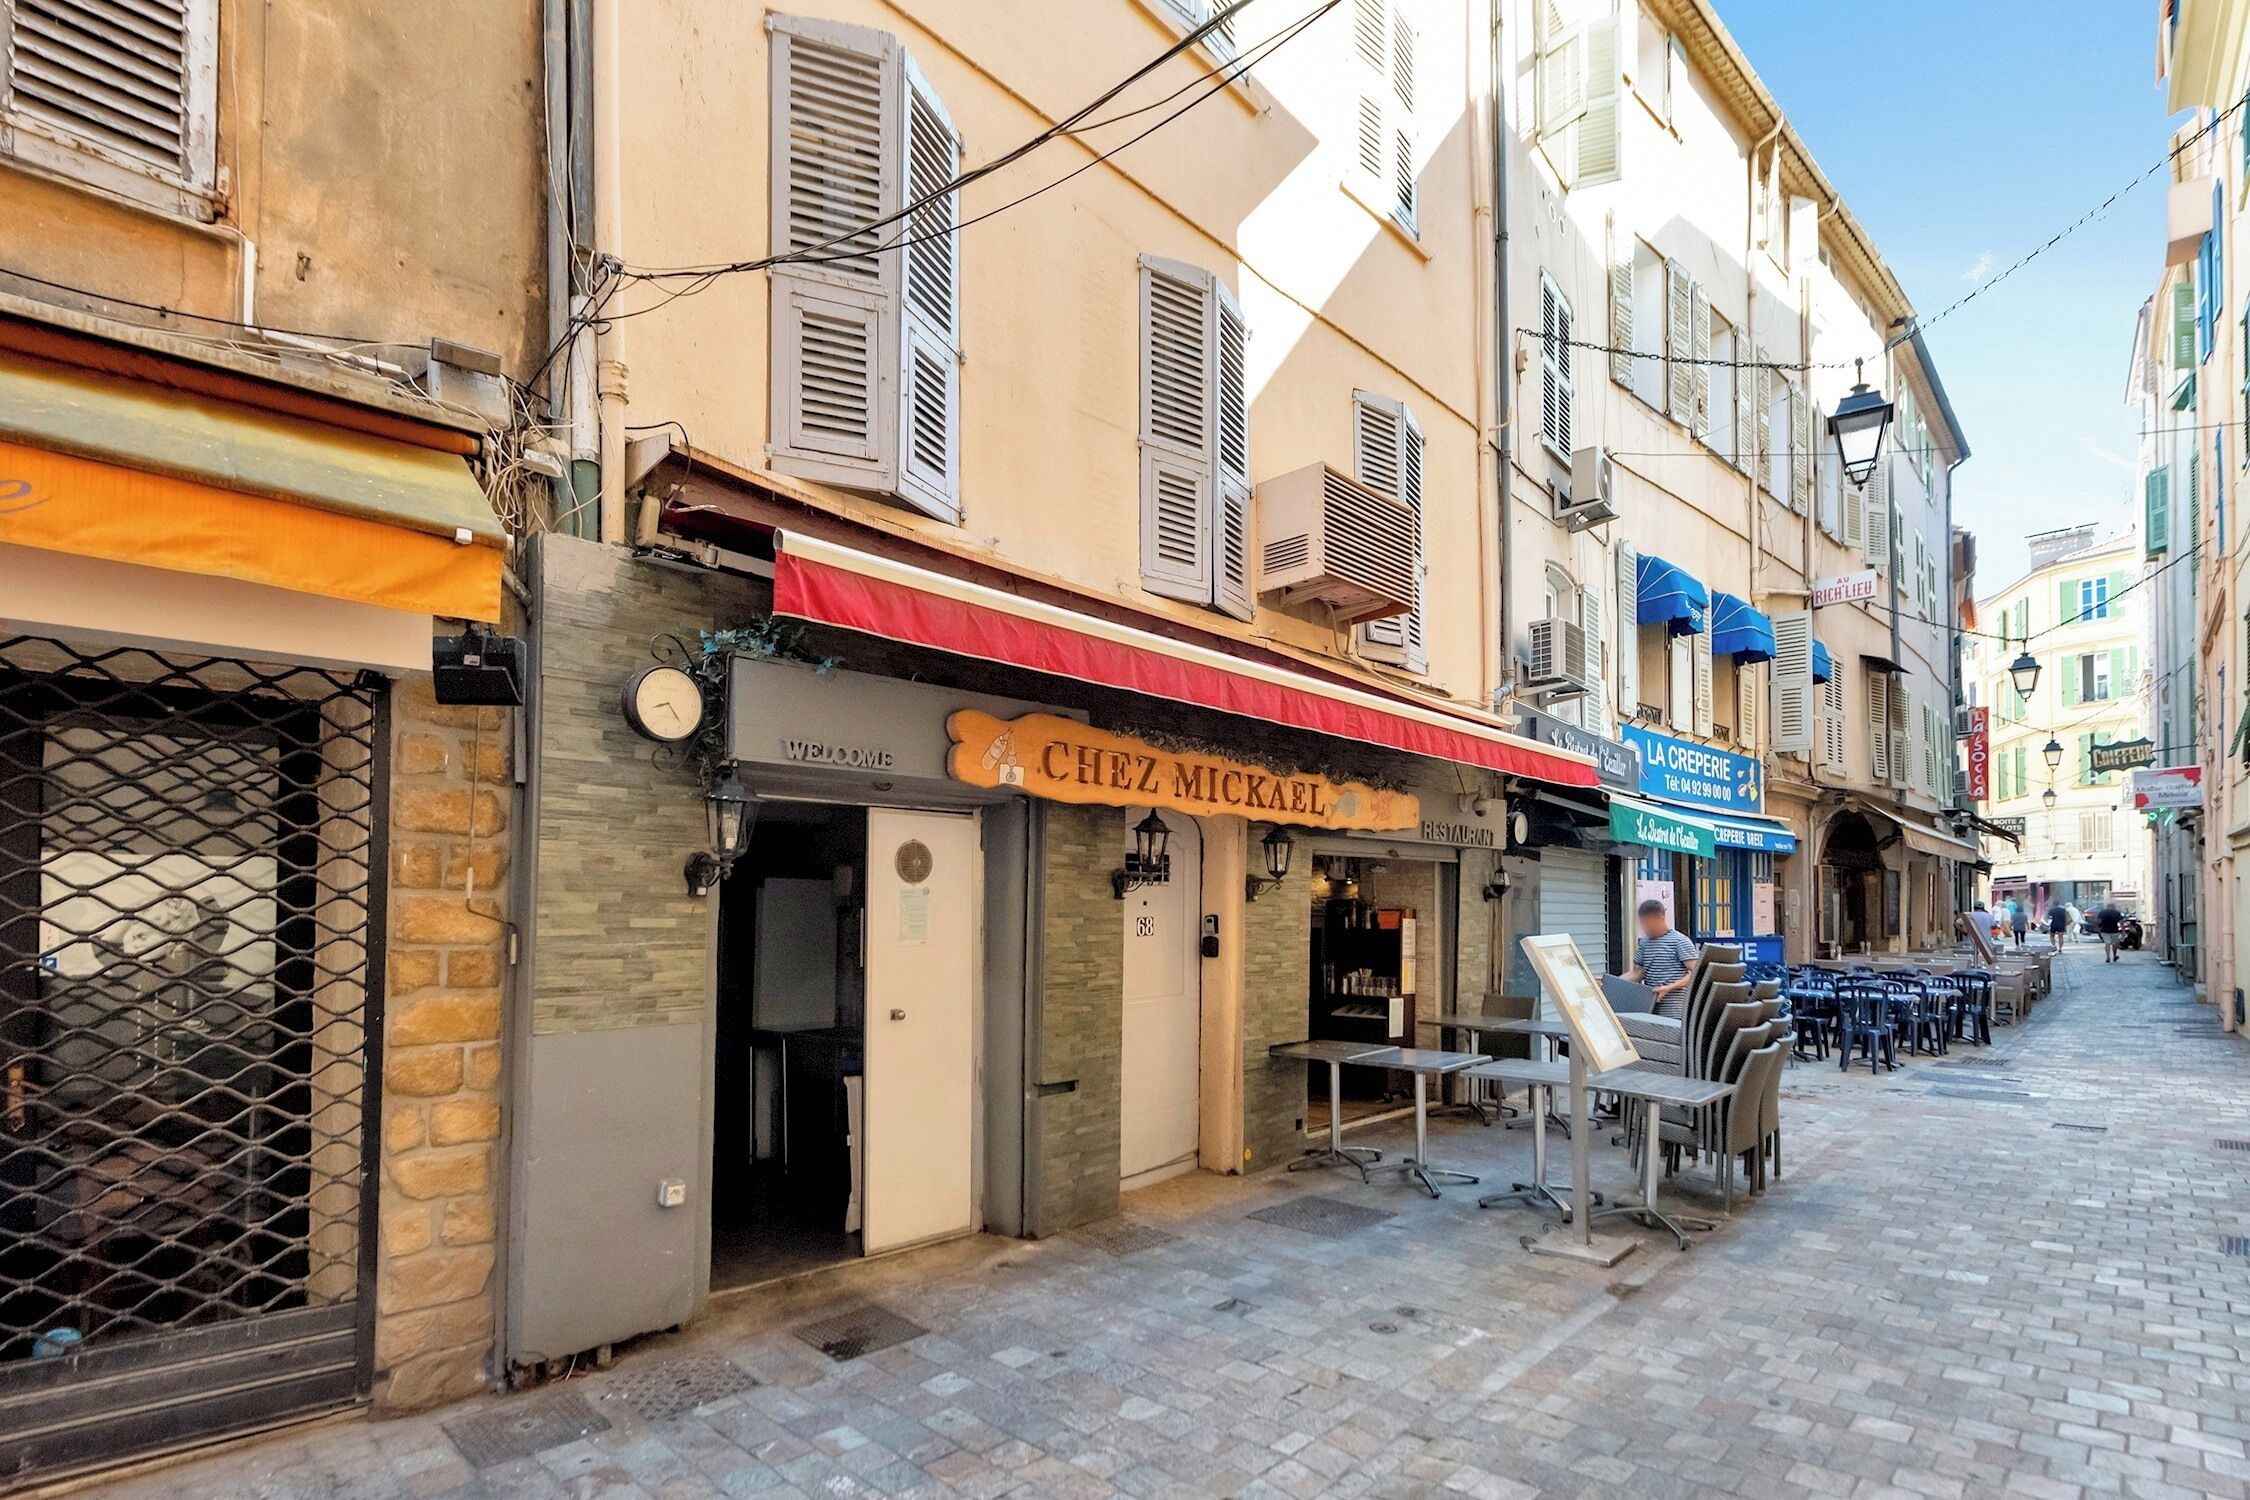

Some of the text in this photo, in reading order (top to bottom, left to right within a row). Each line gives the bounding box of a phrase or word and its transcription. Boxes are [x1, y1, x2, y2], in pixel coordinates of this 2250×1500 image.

[1836, 577, 1850, 585] AU
[1551, 727, 1563, 749] Le
[781, 736, 894, 771] WELCOME
[1647, 739, 1731, 781] LA CREPERIE
[2092, 744, 2153, 768] COIFFEUR
[1041, 741, 1326, 816] CHEZ MICKAEL
[1664, 773, 1731, 802] Tél: 04 92 99 00 00
[1636, 813, 1647, 841] Le
[1714, 827, 1745, 845] CREPERIE
[1137, 917, 1154, 936] 68
